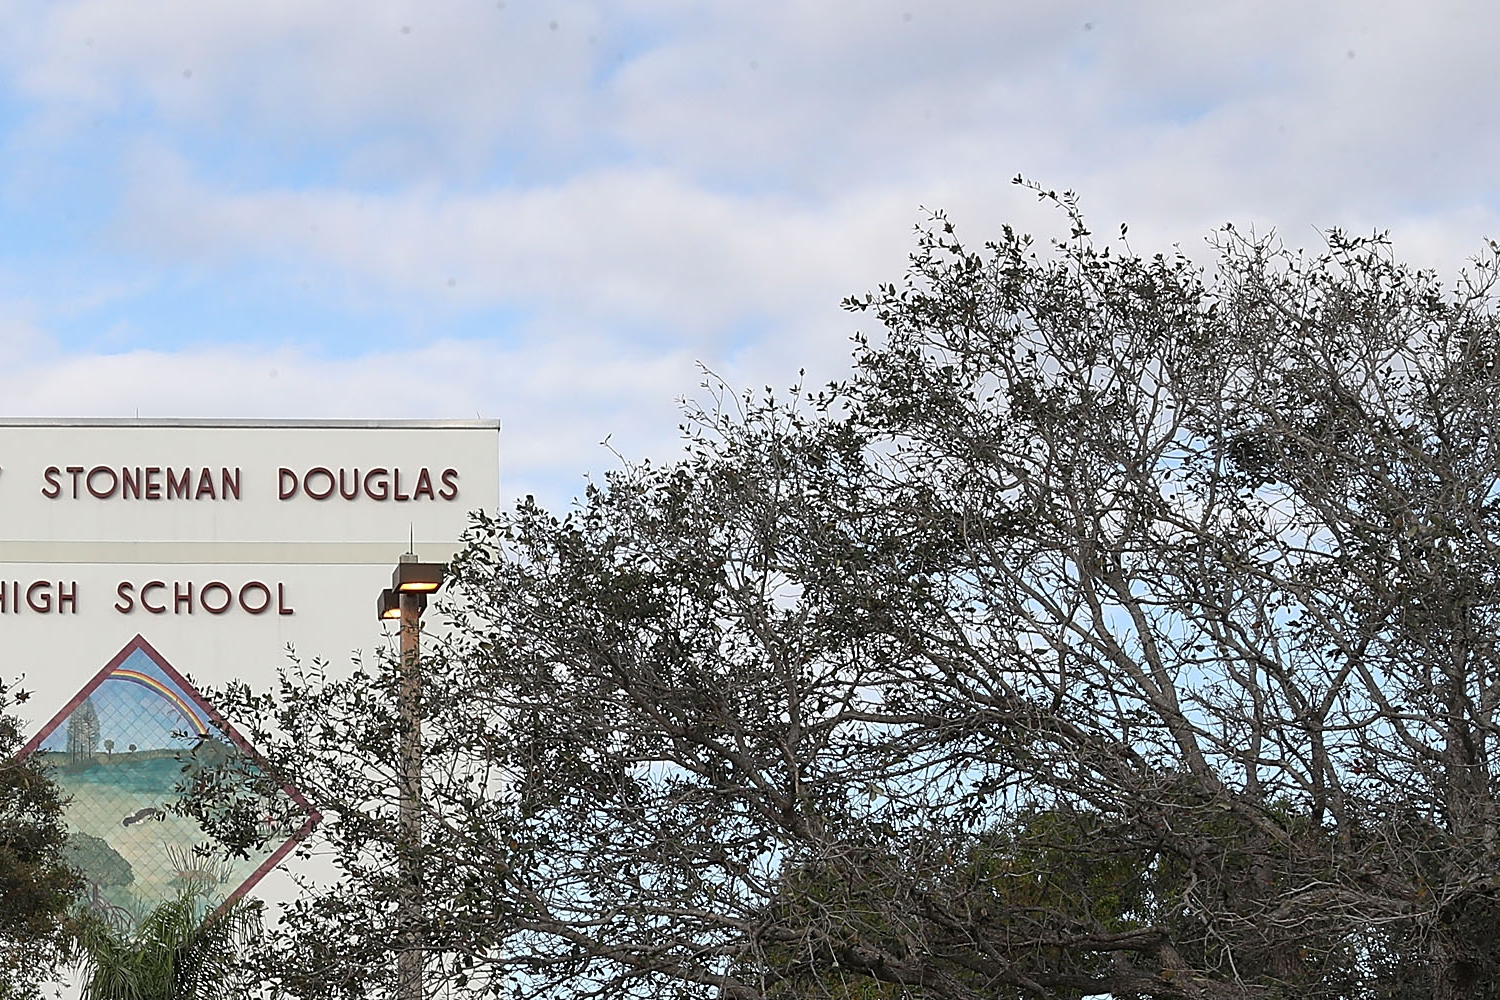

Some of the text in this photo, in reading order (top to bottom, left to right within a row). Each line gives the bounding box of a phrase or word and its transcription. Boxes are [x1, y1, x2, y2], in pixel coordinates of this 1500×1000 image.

[42, 466, 239, 500] STONEMAN
[279, 467, 457, 502] DOUGLAS
[115, 581, 293, 615] SCHOOL
